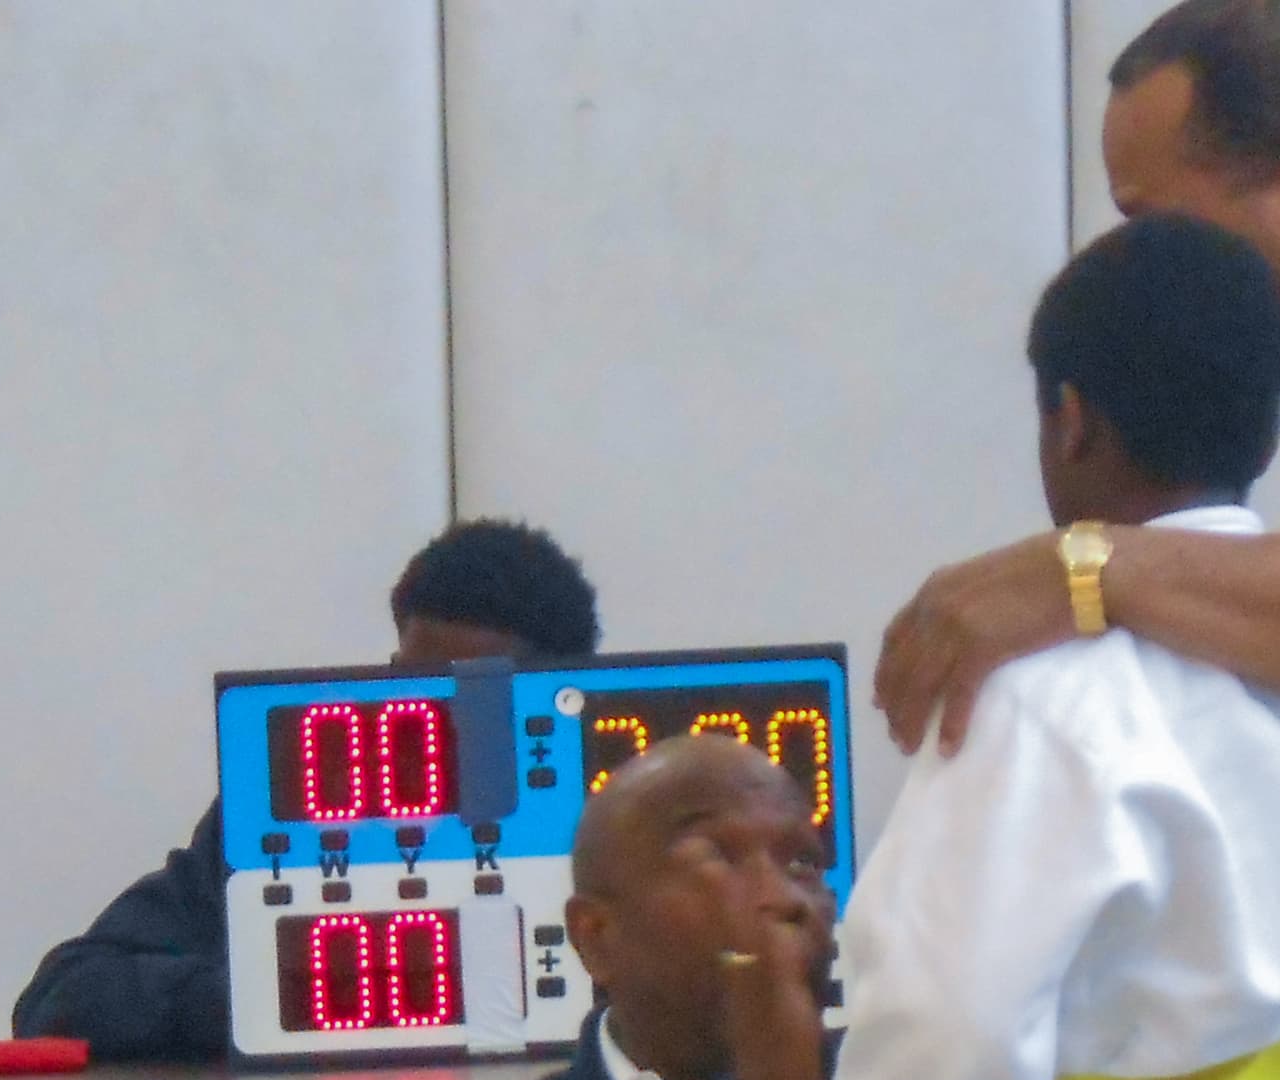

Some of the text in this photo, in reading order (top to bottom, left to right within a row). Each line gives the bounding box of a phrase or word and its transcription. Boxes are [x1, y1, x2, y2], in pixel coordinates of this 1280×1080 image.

[302, 698, 439, 820] 00
[320, 851, 349, 878] W
[400, 847, 423, 874] Y
[476, 845, 500, 871] K
[312, 908, 448, 1031] 00
